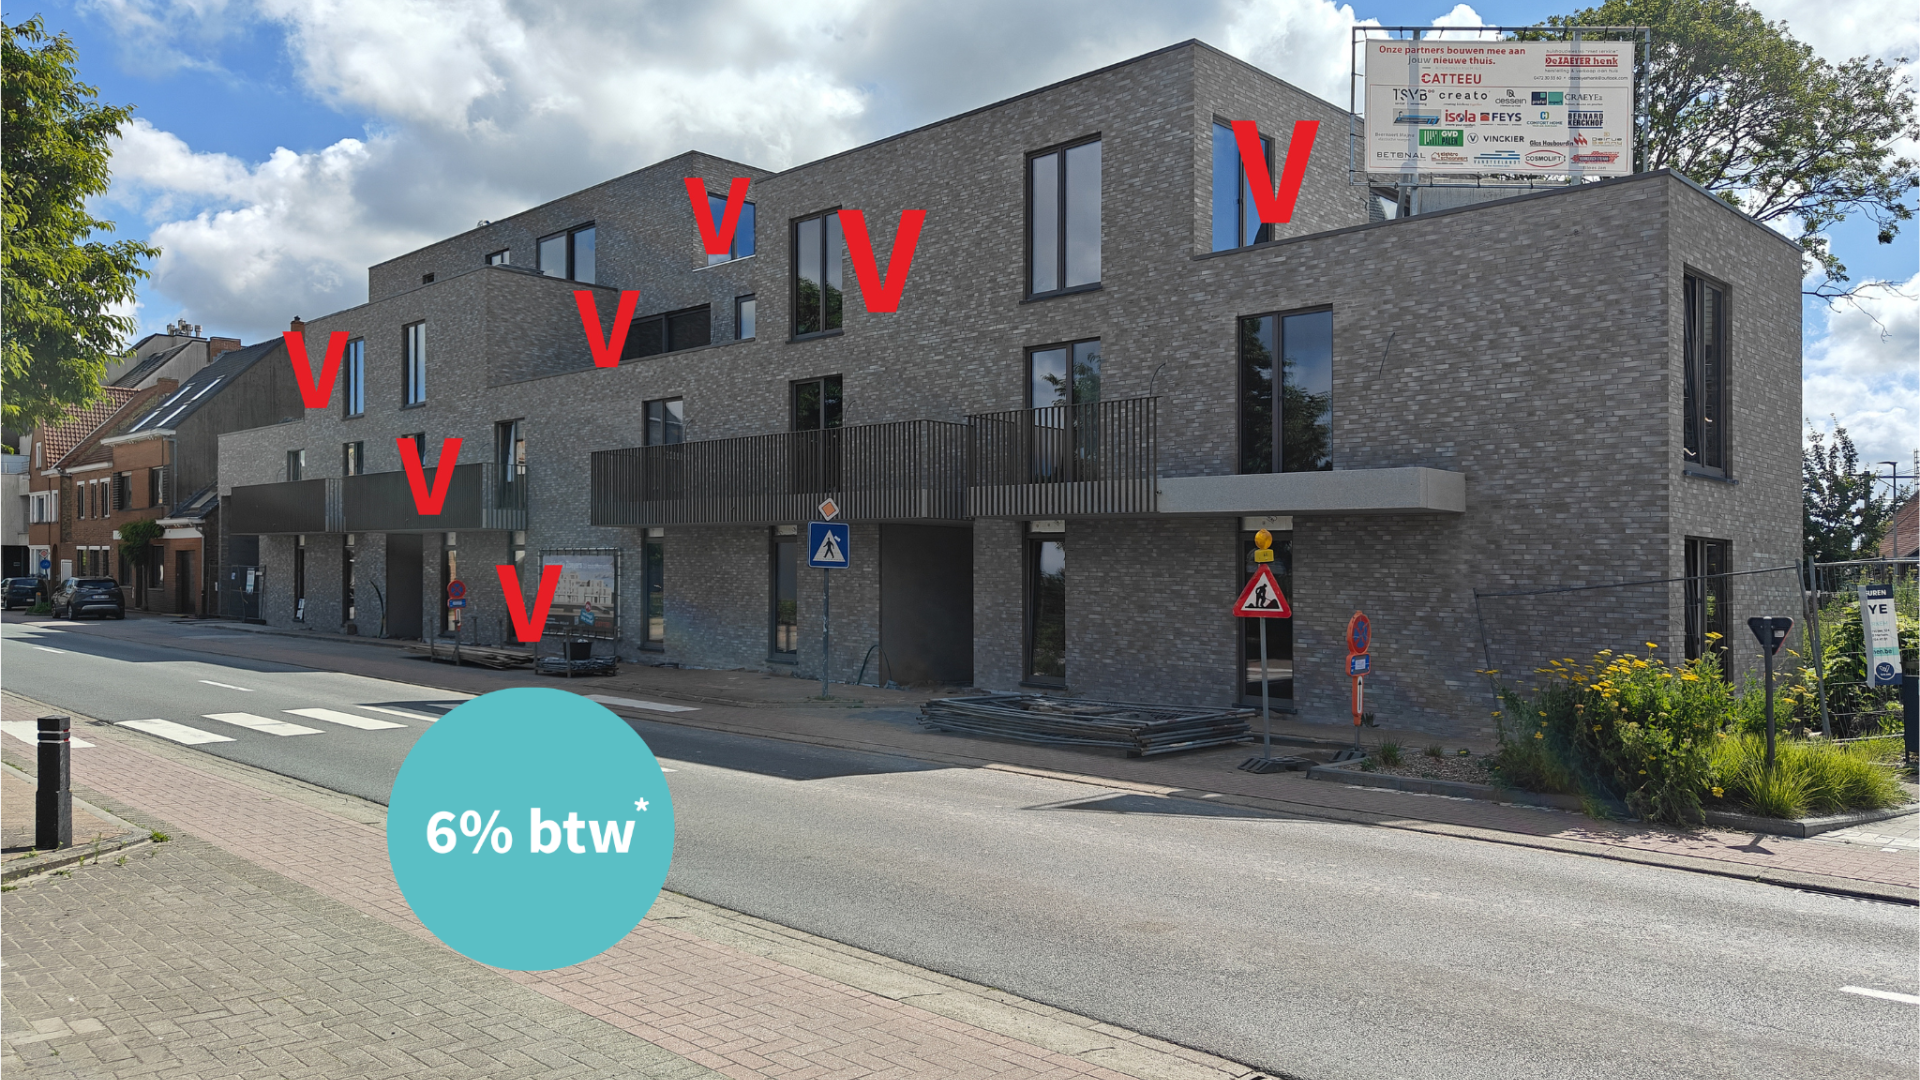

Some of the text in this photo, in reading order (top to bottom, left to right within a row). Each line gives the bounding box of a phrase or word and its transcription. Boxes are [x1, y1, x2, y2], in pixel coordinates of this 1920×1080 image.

[1379, 45, 1403, 54] Onze
[1404, 45, 1445, 55] partners
[1446, 46, 1484, 55] bouwen
[1408, 55, 1496, 65] jouw nieuwe thuis.
[1593, 57, 1619, 65] henk
[1421, 73, 1482, 84] CATTEEU
[1439, 91, 1488, 100] creato
[1445, 109, 1476, 122] isola
[1492, 112, 1522, 122] FEYS
